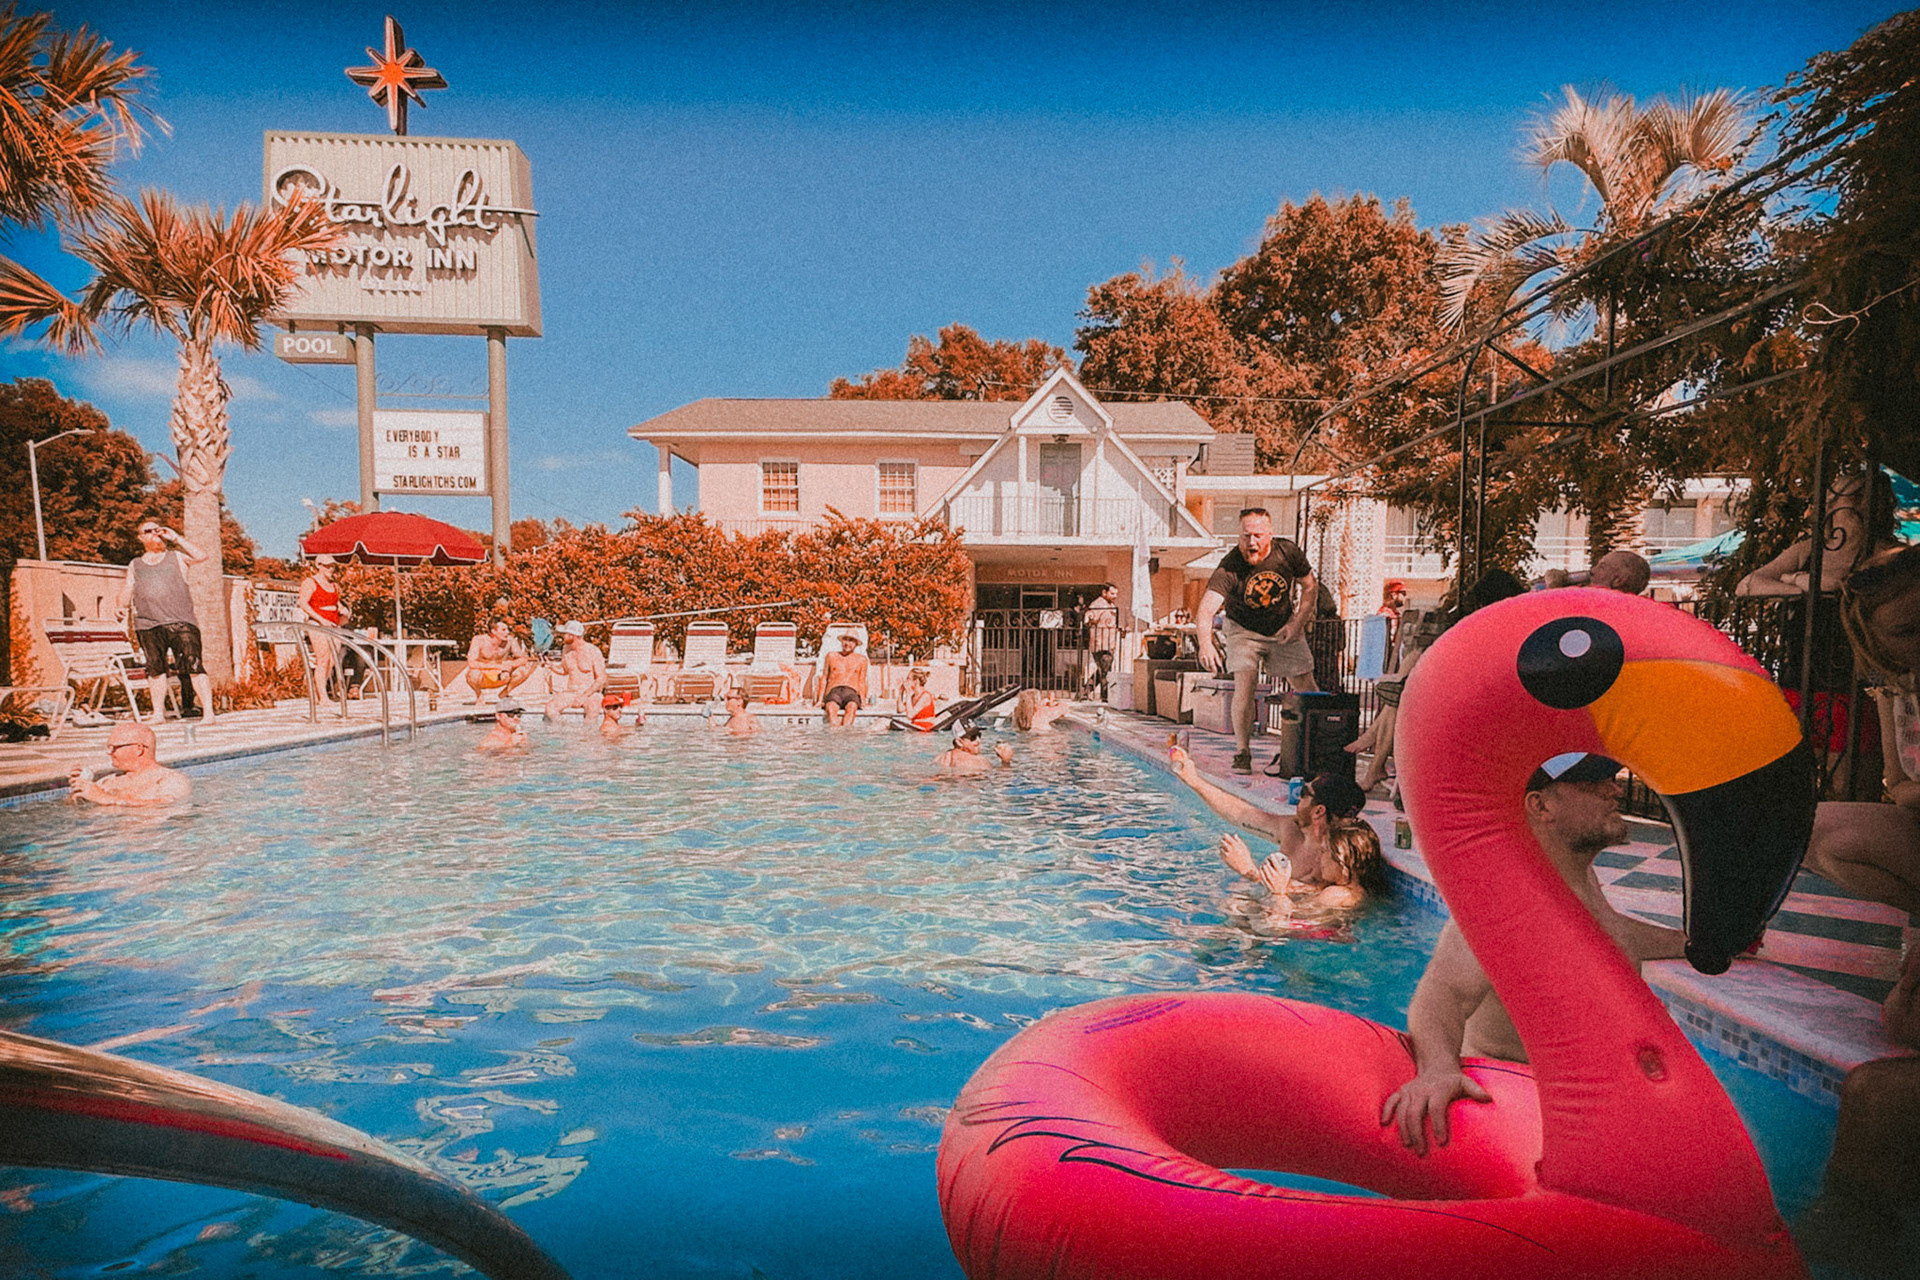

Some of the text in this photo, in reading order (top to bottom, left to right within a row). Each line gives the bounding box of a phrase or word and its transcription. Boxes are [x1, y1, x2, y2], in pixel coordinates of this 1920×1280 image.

[426, 247, 476, 270] INN
[283, 337, 337, 354] POOL
[386, 430, 439, 442] EVERYBODY
[408, 445, 460, 458] IS A STAR
[1007, 569, 1073, 578] MOTOR INN
[260, 593, 269, 606] NO
[269, 608, 278, 621] ON
